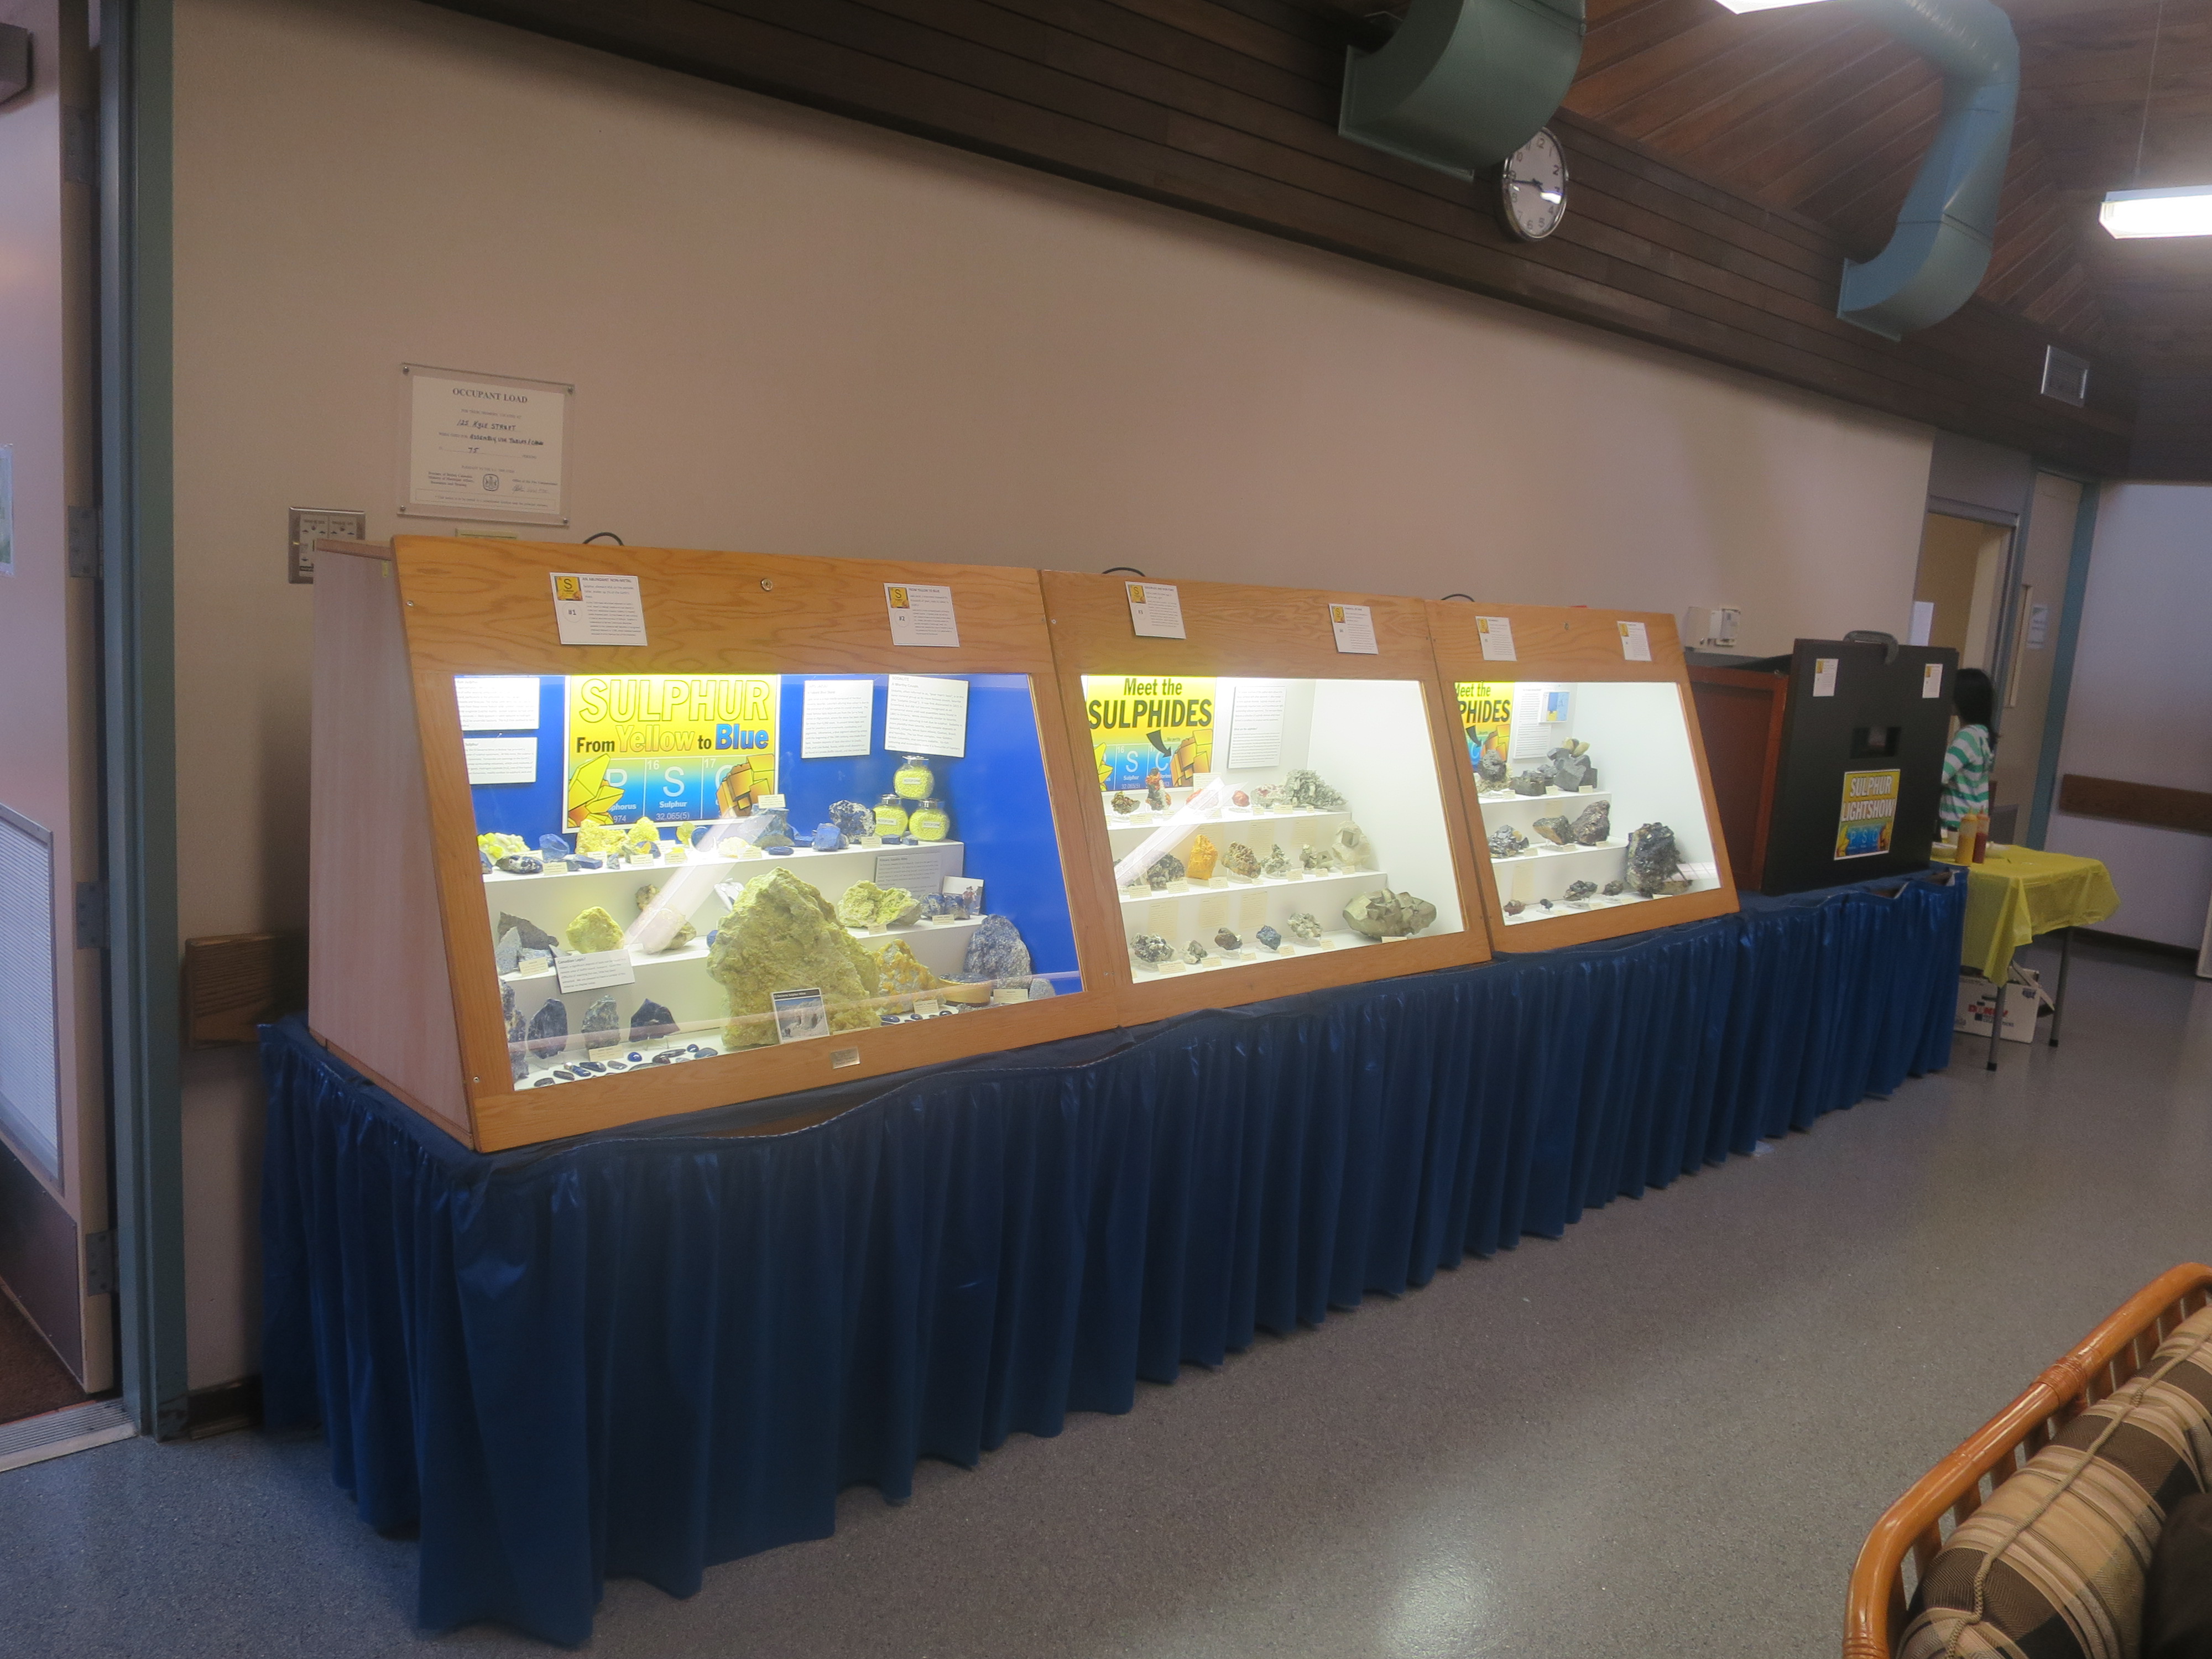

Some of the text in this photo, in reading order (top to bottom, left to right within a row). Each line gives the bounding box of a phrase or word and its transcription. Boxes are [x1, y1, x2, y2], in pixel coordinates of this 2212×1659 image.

[452, 388, 528, 403] OCCUPANT LOAD
[564, 578, 572, 589] S
[1134, 586, 1139, 595] S
[895, 589, 902, 598] S
[1123, 677, 1183, 696] Meet the
[1477, 682, 1491, 697] the
[579, 679, 770, 723] SULPHUR
[1088, 698, 1213, 729] SULPHIDES
[1458, 700, 1511, 723] PHIDES
[576, 723, 769, 753] From Yellow to Blue
[647, 760, 660, 770] 16
[704, 758, 717, 769] 17
[1125, 750, 1138, 773] S
[606, 768, 628, 787] P
[663, 766, 685, 797] S
[1850, 776, 1892, 797] SULPHUR
[610, 803, 637, 812] phorus
[1841, 799, 1897, 821] LIGHTSHOW
[656, 812, 690, 821] 32.065(5)
[1862, 830, 1867, 843] S
